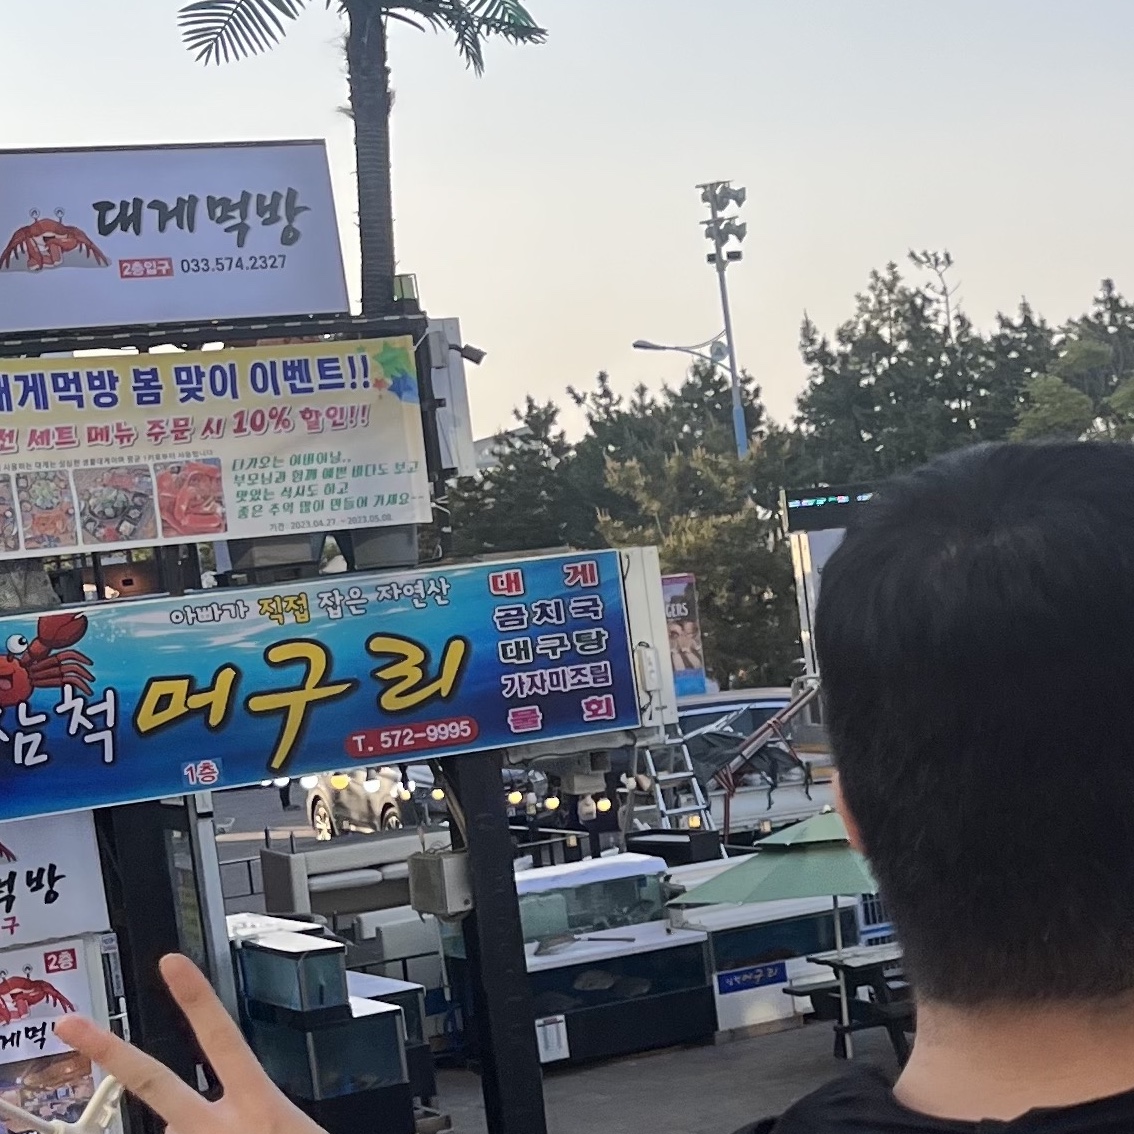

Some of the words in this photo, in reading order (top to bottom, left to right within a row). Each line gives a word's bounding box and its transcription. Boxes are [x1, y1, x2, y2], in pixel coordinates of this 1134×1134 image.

[92, 187, 311, 248] 대게먹방
[121, 261, 172, 277] 2층입구
[180, 254, 287, 273] 033.574.2327
[132, 367, 163, 406] 봄
[174, 363, 239, 403] 맞이
[250, 355, 370, 396] 이벤트!!
[27, 426, 78, 449] 세트
[87, 422, 136, 445] 메뉴
[147, 417, 193, 443] 주문
[201, 417, 225, 437] 시
[233, 405, 293, 434] 10%
[299, 404, 369, 432] 할인!!
[231, 456, 285, 471] 다가오는
[233, 471, 286, 487] 부모님과
[235, 487, 275, 503] 맛있는
[280, 484, 319, 499] 식사도
[323, 481, 349, 495] 하고
[268, 502, 294, 517] 추억
[170, 599, 250, 625] 아빠가
[257, 592, 311, 625] 직접
[317, 586, 369, 619] 잡은
[376, 576, 451, 608] 자연산
[494, 596, 603, 631] 곰치국
[498, 628, 608, 664] 대구탕
[501, 660, 612, 698] 가자미조림
[135, 636, 467, 771] 머구리
[379, 720, 472, 750] 572-9995
[184, 760, 219, 785] 1층
[46, 951, 75, 971] 2층
